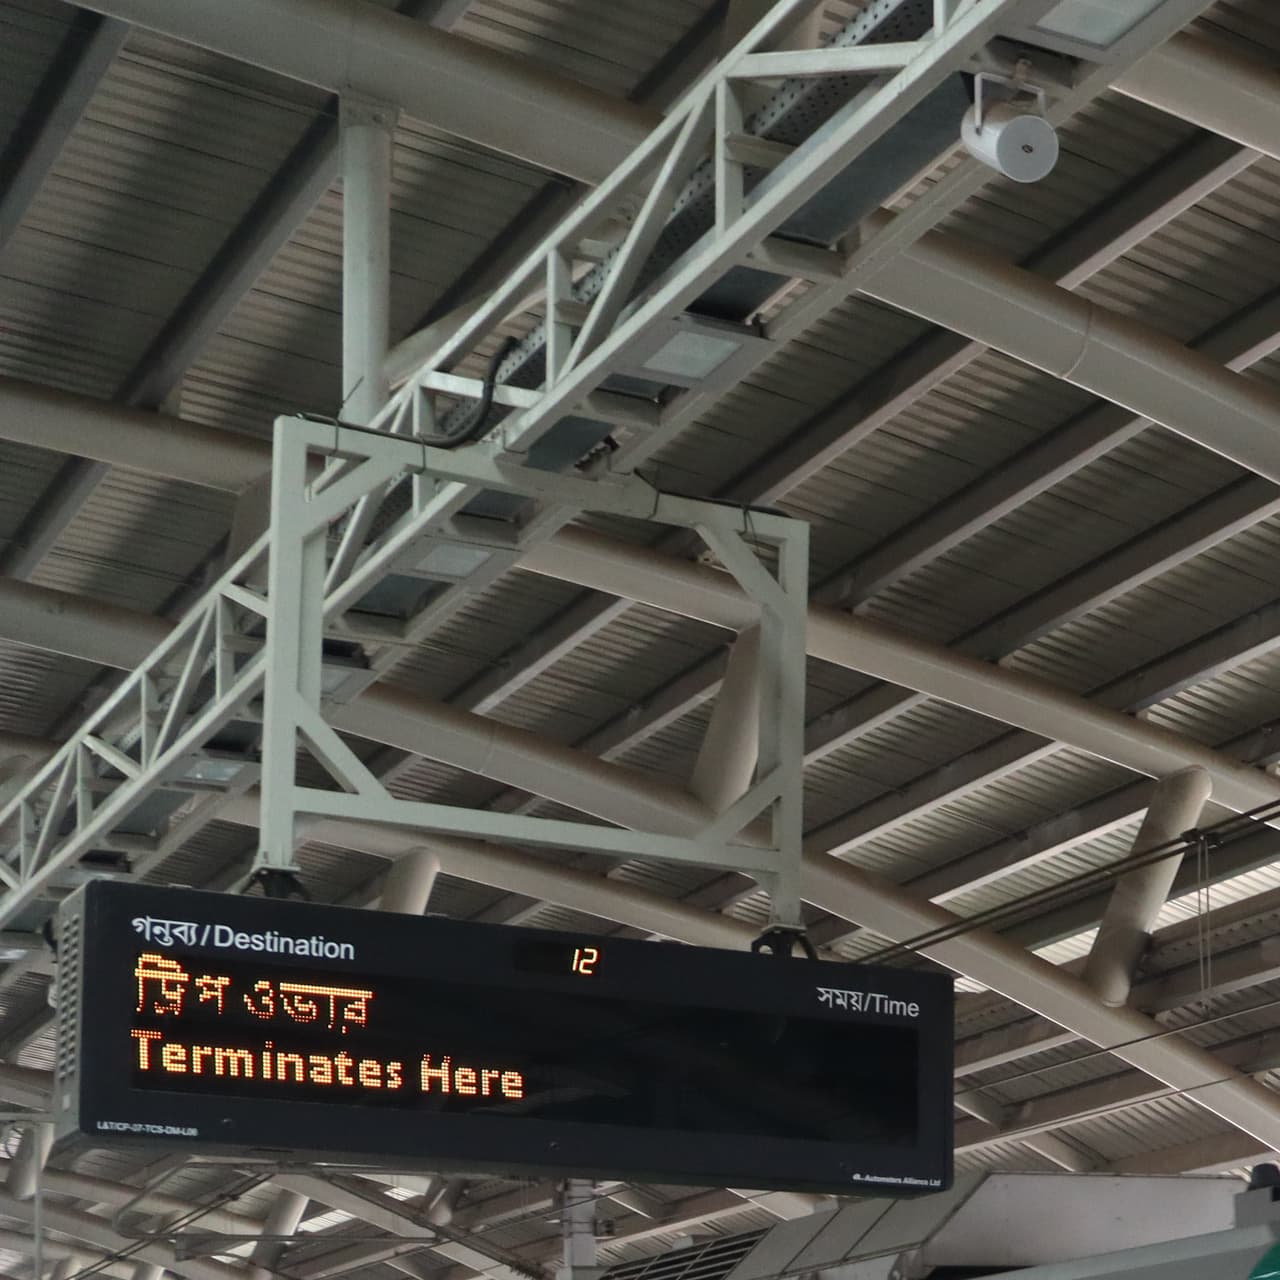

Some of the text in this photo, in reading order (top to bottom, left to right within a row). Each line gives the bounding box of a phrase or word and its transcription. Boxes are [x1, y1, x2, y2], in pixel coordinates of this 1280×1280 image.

[572, 948, 599, 975] 12
[130, 1028, 524, 1099] Terminates Here
